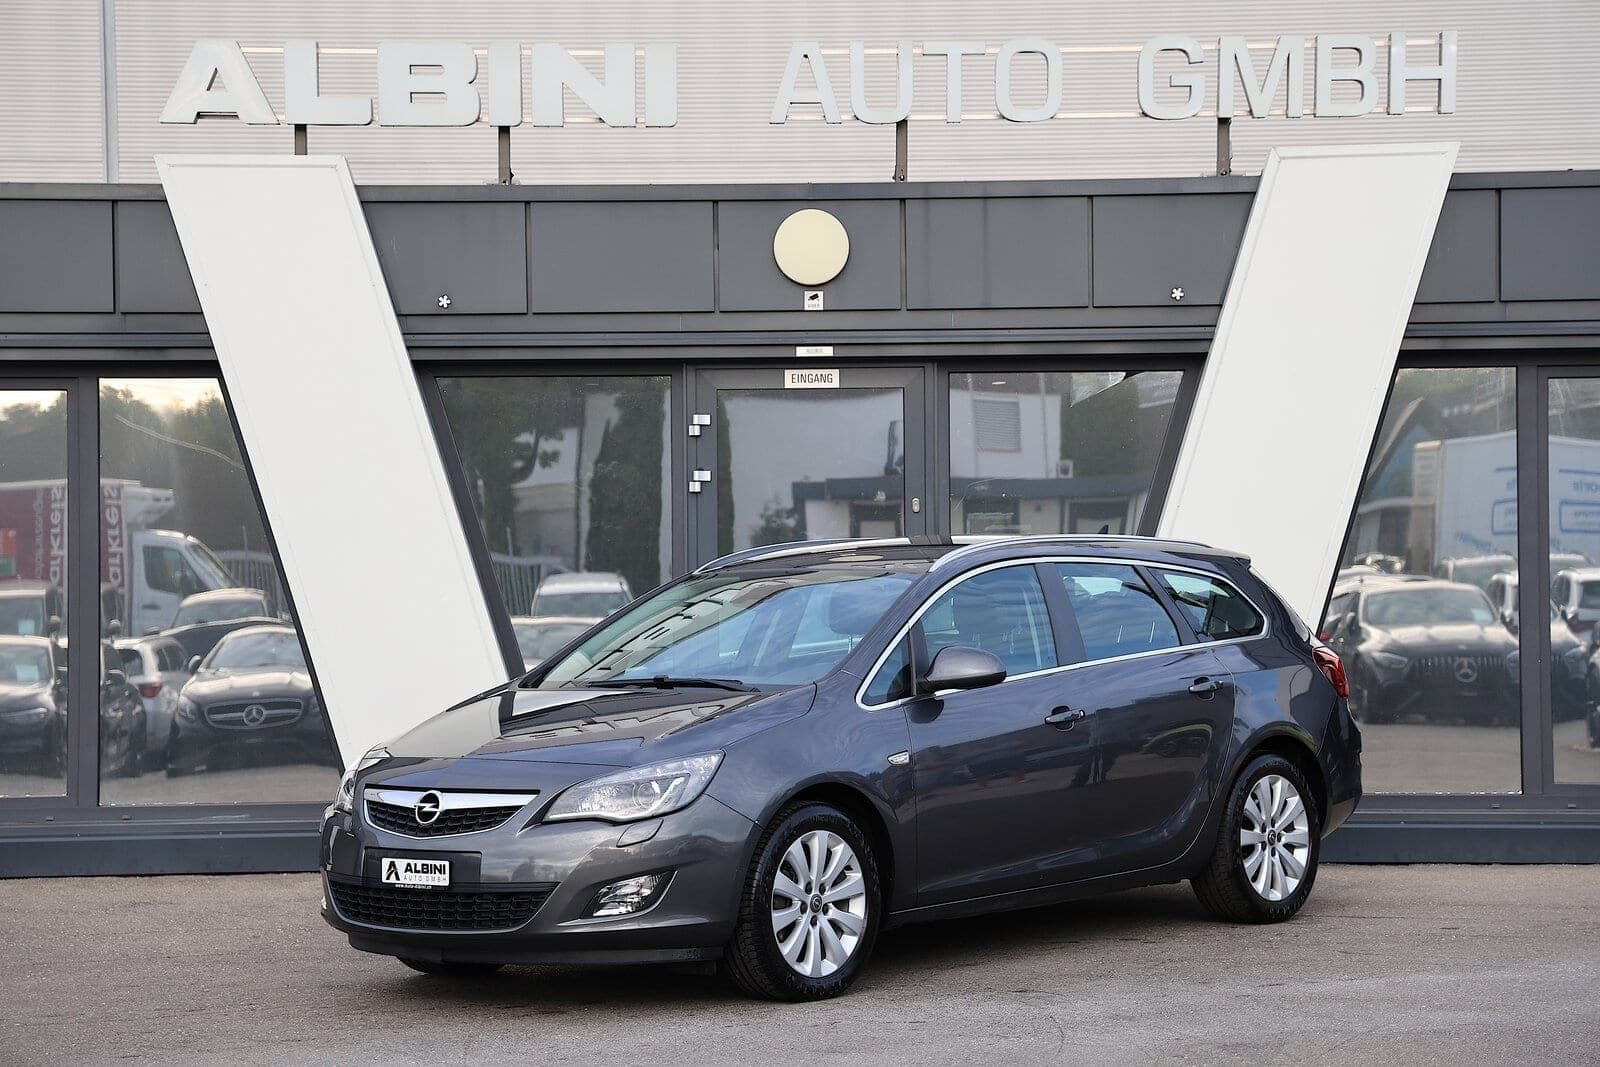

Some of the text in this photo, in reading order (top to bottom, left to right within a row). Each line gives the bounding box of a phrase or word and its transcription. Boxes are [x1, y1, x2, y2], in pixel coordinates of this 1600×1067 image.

[159, 30, 1459, 127] ALBINI AUTO GMBH
[791, 373, 833, 384] EINGANG
[404, 862, 446, 875] ALBINI
